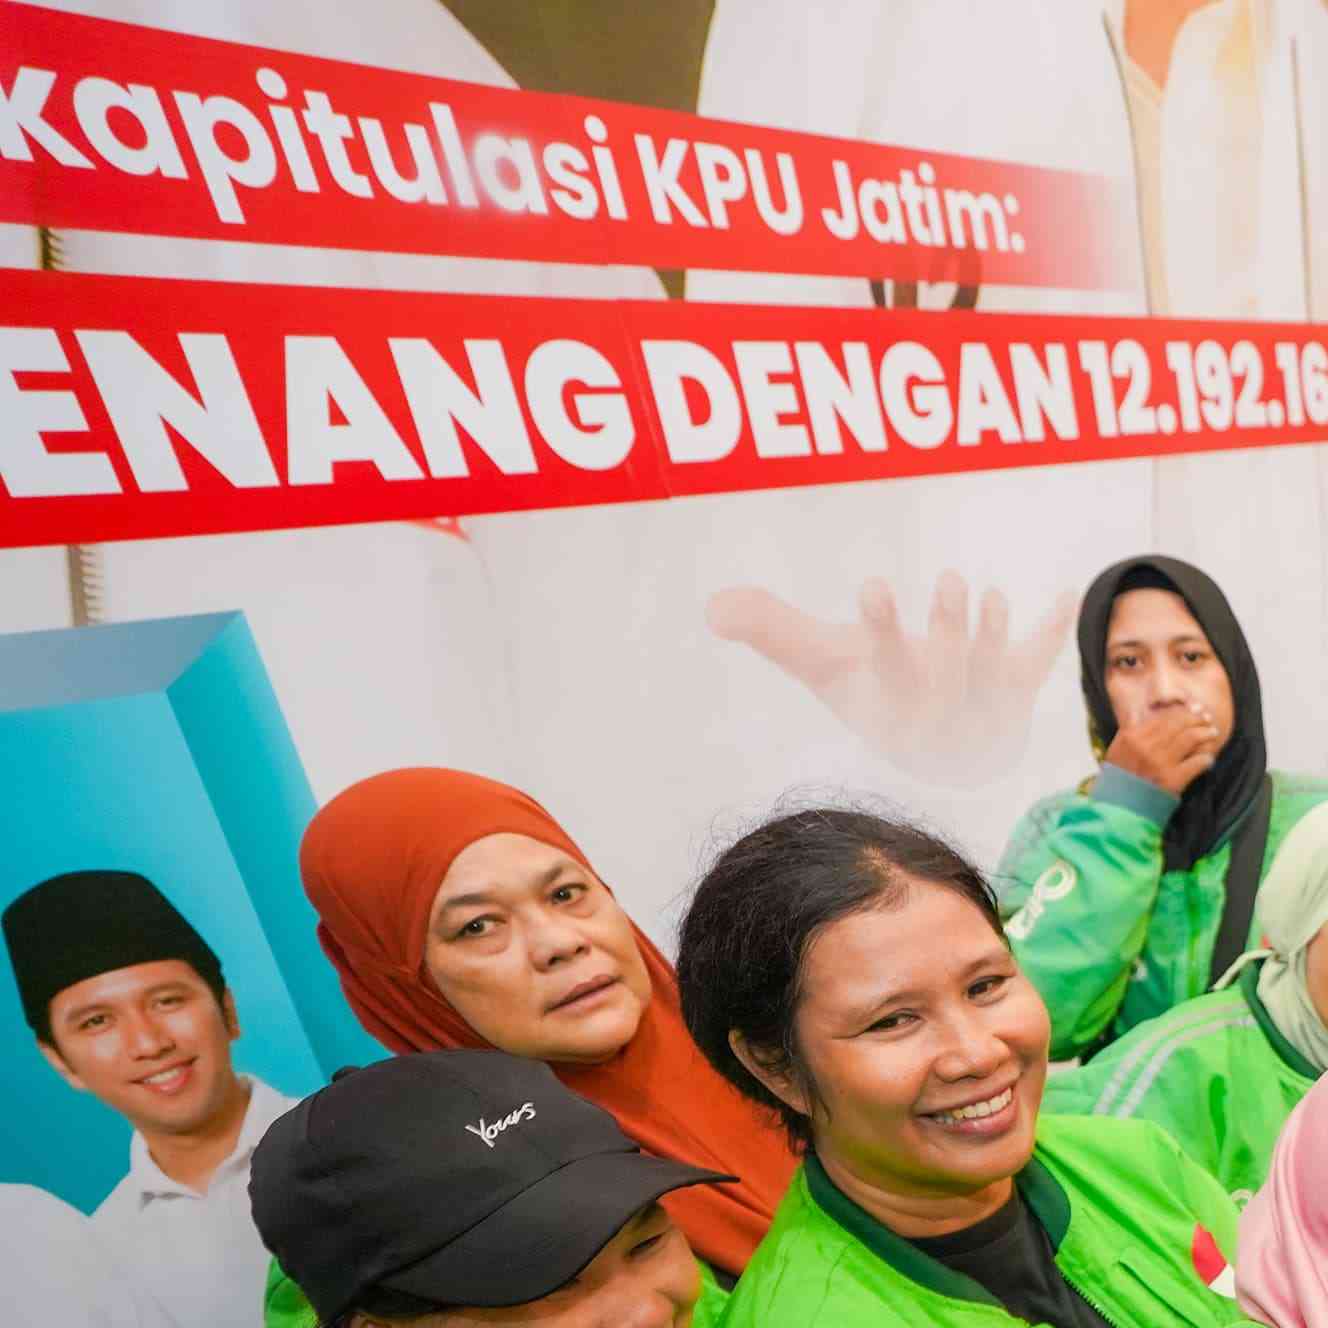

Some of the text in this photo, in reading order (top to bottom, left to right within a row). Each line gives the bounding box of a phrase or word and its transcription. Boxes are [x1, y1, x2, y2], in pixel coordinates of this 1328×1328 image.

[0, 66, 1027, 253] kapitulasi KPU Jatim:
[0, 326, 636, 499] ENANG
[639, 340, 1080, 464] DENGAN
